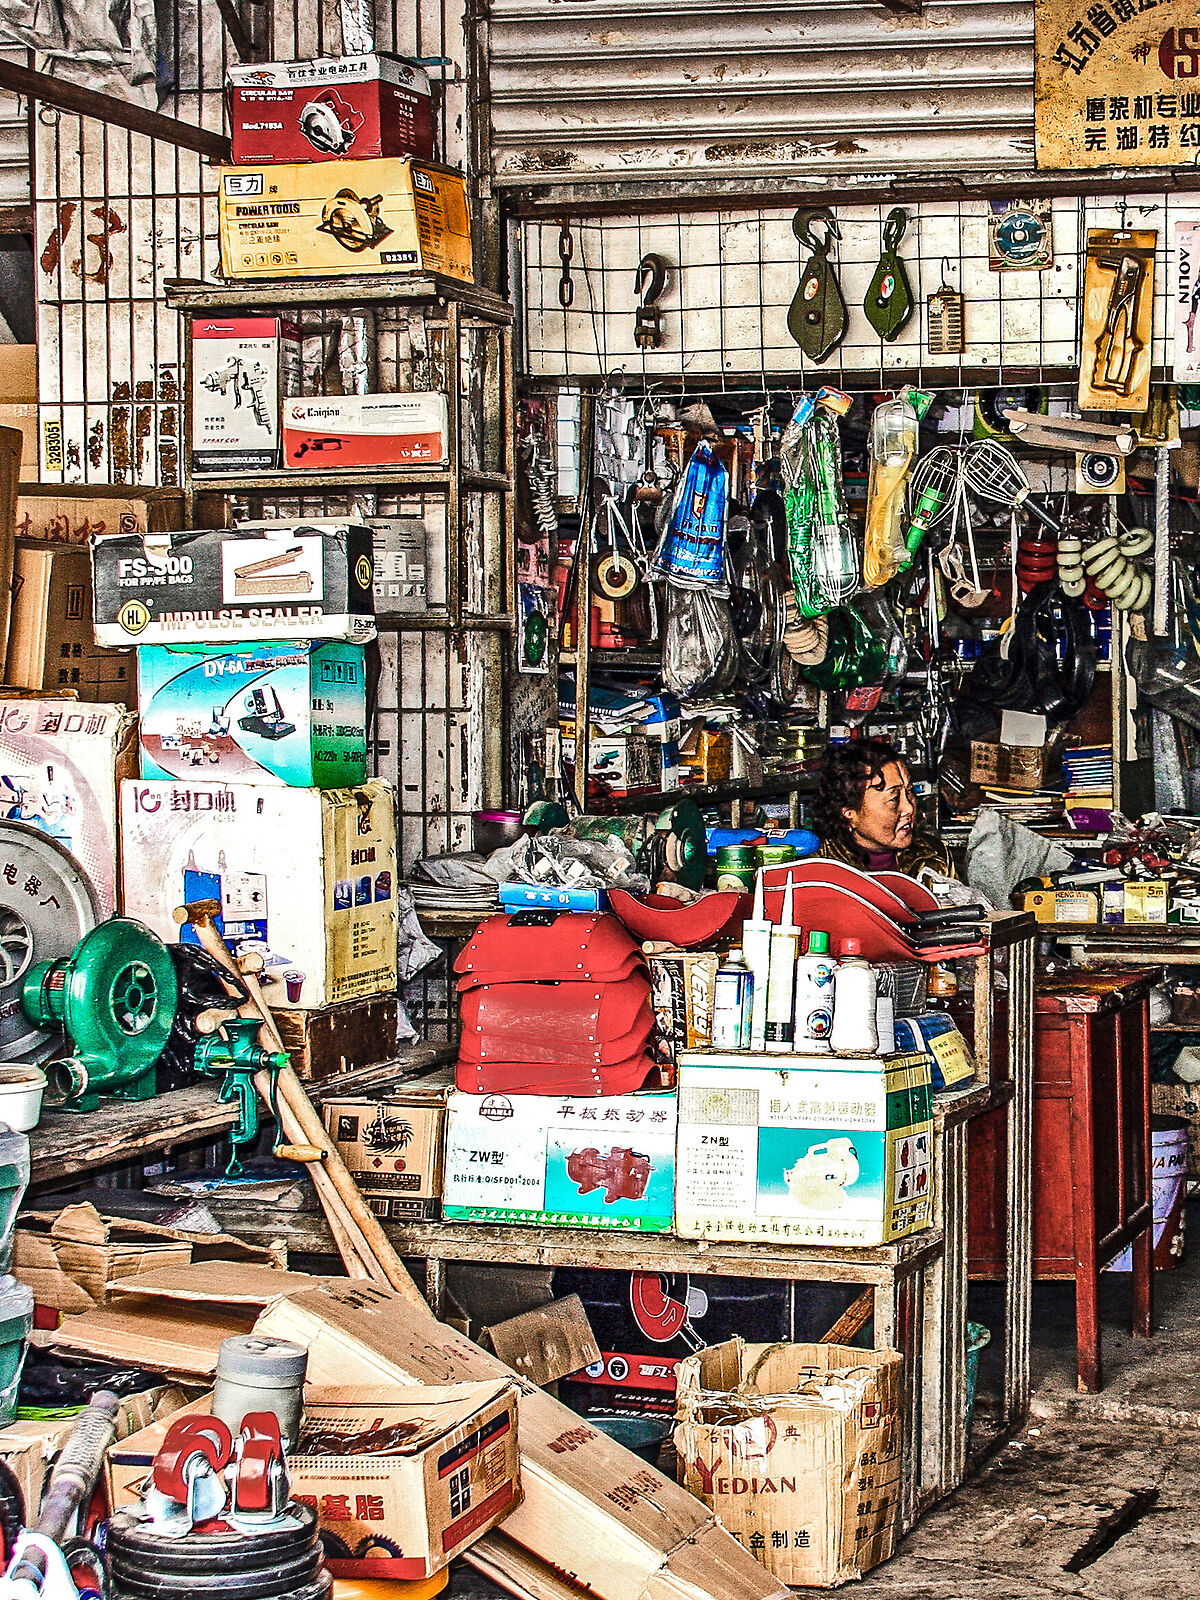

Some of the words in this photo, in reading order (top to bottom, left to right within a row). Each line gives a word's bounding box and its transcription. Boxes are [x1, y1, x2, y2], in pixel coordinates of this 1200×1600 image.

[229, 177, 260, 192] 巨力
[236, 205, 269, 216] POWER
[270, 203, 300, 215] TOOLS
[49, 422, 61, 465] 3283051
[120, 578, 136, 586] FOR
[169, 575, 193, 584] BAGS
[127, 607, 141, 623] HL
[159, 610, 242, 631] IMPULSE
[247, 606, 323, 627] SEALER
[39, 713, 107, 735] 封口机
[170, 790, 237, 812] 封口机
[556, 1105, 668, 1123] 平板振动器
[469, 1151, 505, 1165] ZW型
